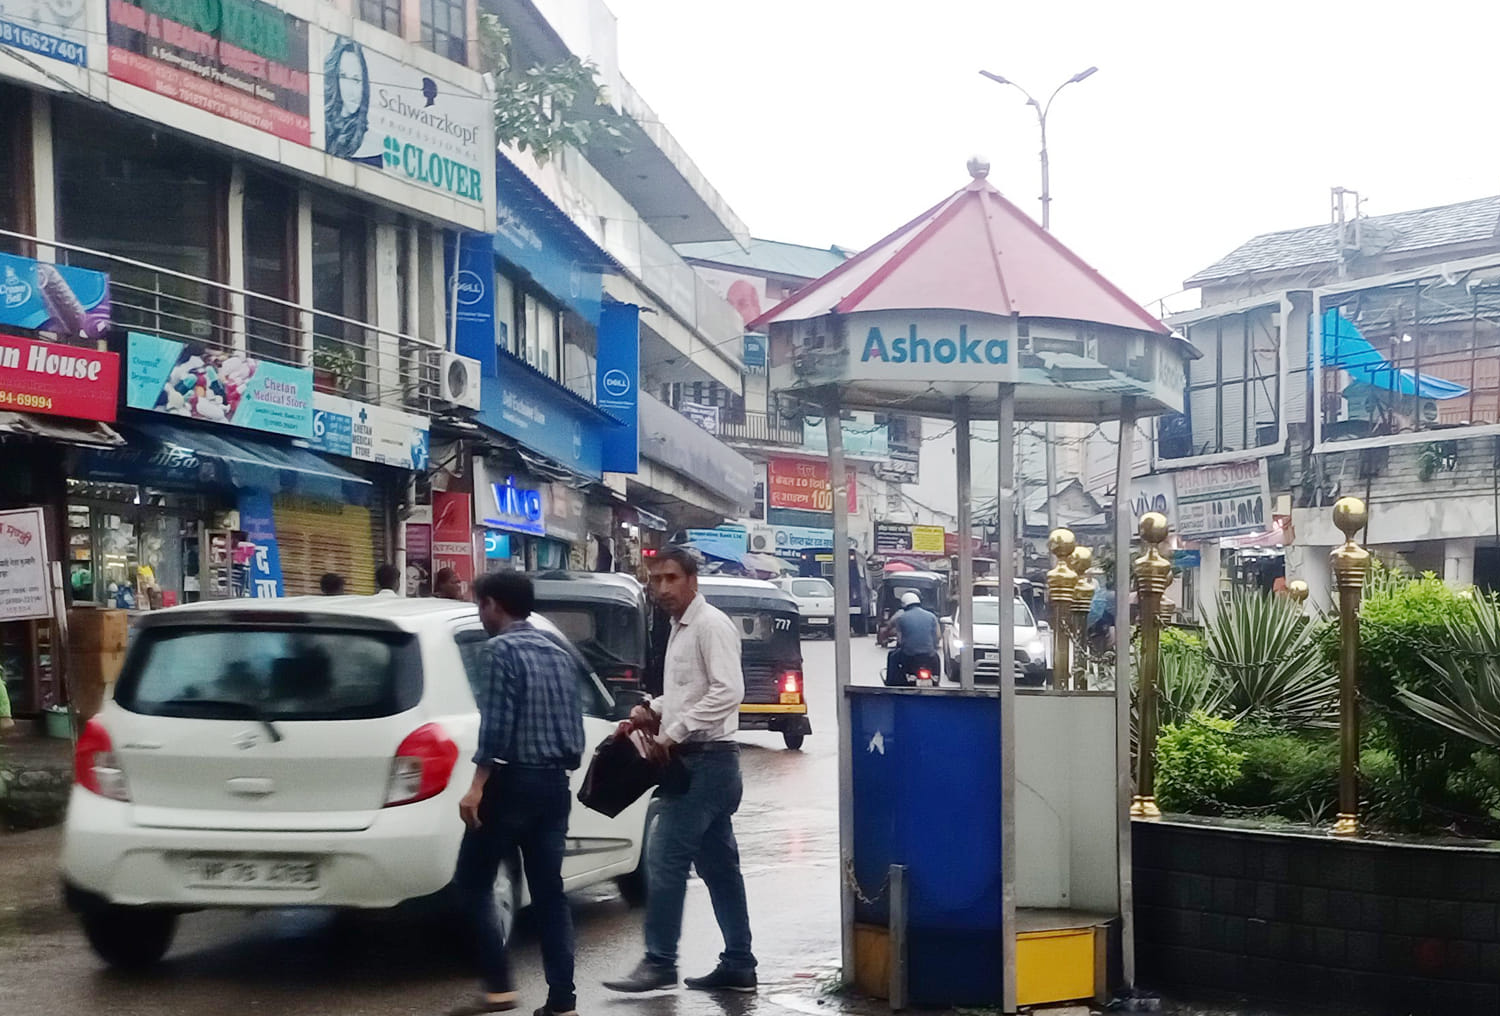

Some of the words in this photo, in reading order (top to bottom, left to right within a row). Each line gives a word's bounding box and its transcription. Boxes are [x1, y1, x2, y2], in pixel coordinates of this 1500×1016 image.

[0, 22, 84, 63] 816627401
[379, 89, 480, 146] Schwarzkopf
[403, 143, 483, 202] CLOVER
[27, 345, 101, 381] House
[861, 324, 1008, 364] Ashoka
[254, 389, 284, 405] Medical
[286, 395, 307, 410] Store
[264, 377, 296, 395] Chetan
[1222, 460, 1260, 483] STORE
[490, 475, 540, 520] vivo
[811, 489, 833, 511] 100
